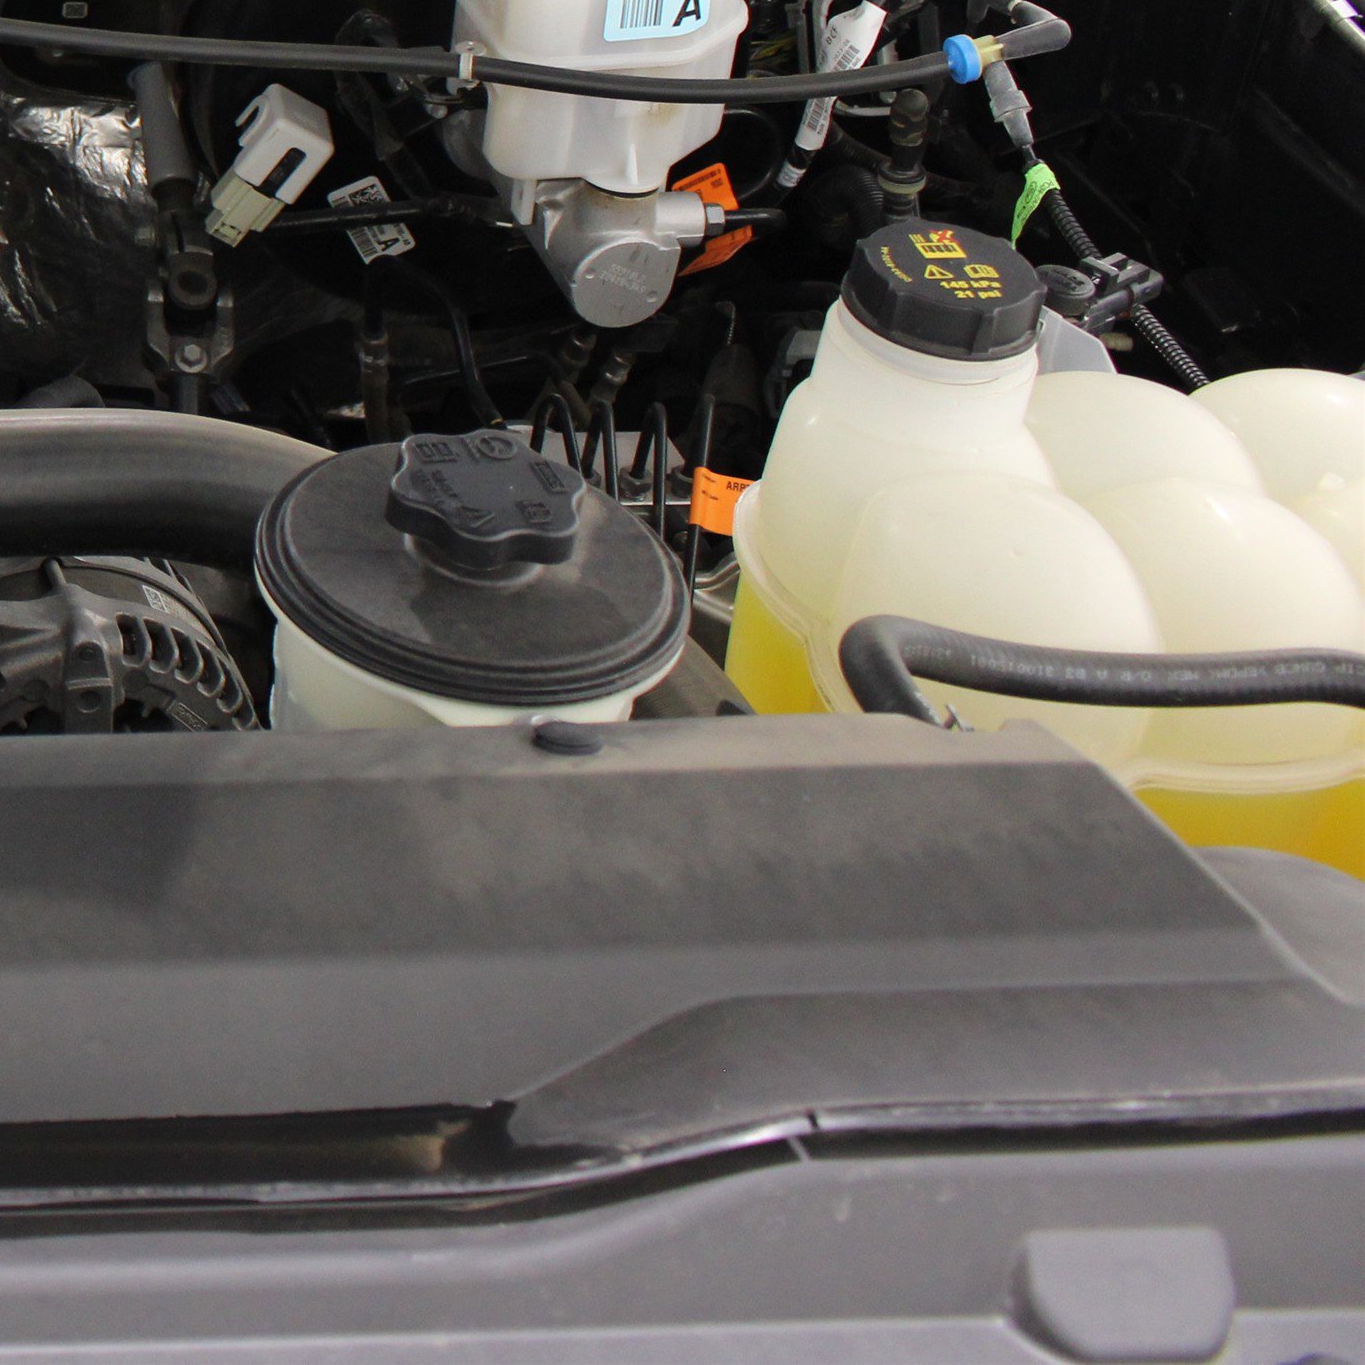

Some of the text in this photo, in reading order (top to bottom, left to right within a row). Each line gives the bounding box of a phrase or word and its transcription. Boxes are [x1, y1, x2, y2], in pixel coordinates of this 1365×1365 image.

[939, 280, 969, 290] 145
[954, 290, 1002, 300] 21 psi
